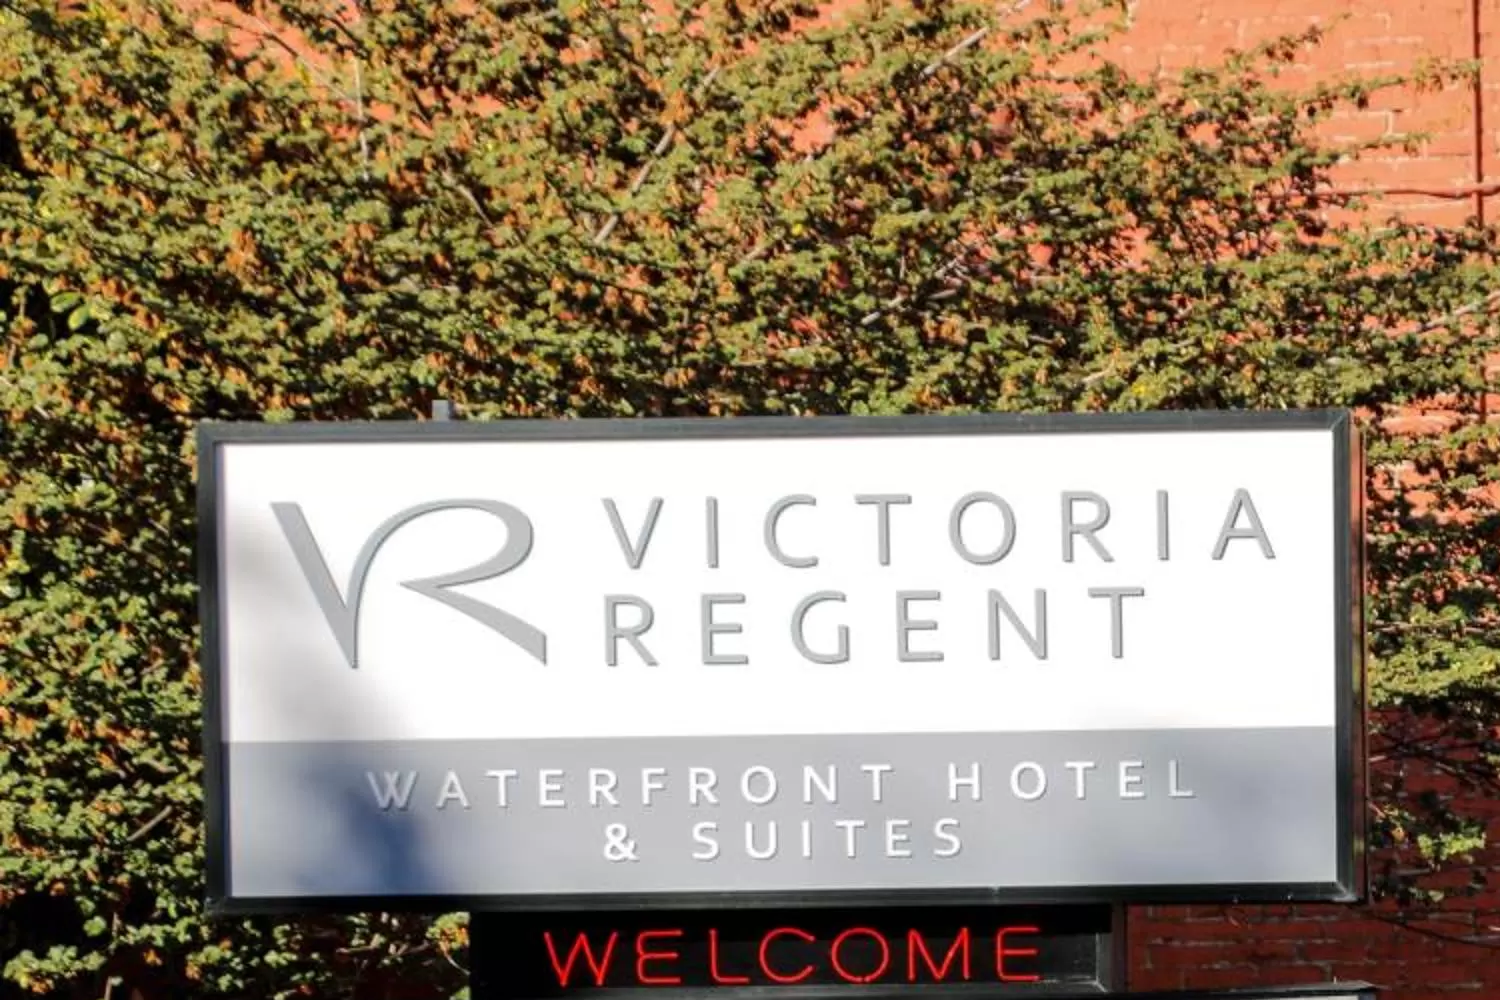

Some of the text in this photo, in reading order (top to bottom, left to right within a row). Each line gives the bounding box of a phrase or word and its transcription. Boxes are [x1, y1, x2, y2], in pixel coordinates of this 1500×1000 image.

[602, 487, 1277, 570] VICTORIA
[603, 586, 1146, 667] REGENT
[367, 759, 1196, 811] WATERFRONT HOTEL
[602, 818, 964, 862] & SUITES
[544, 926, 1042, 986] WELCOME
